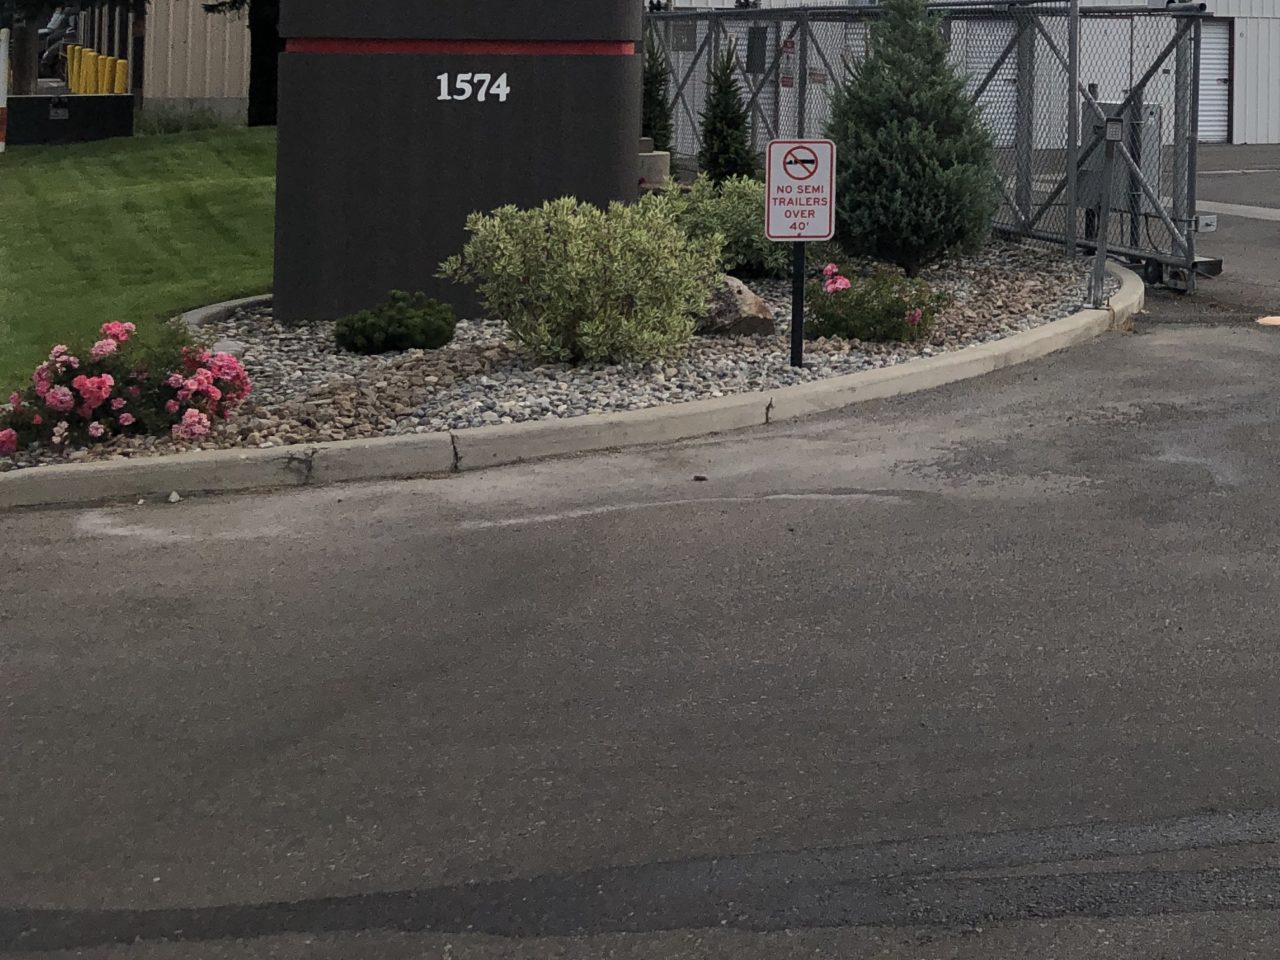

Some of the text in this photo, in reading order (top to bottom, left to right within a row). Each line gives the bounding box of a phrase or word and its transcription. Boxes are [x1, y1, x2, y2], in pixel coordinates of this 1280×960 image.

[436, 72, 511, 102] 1574
[776, 185, 824, 194] NO SEMI
[772, 197, 828, 206] TRAILERS
[784, 209, 815, 218] OVER
